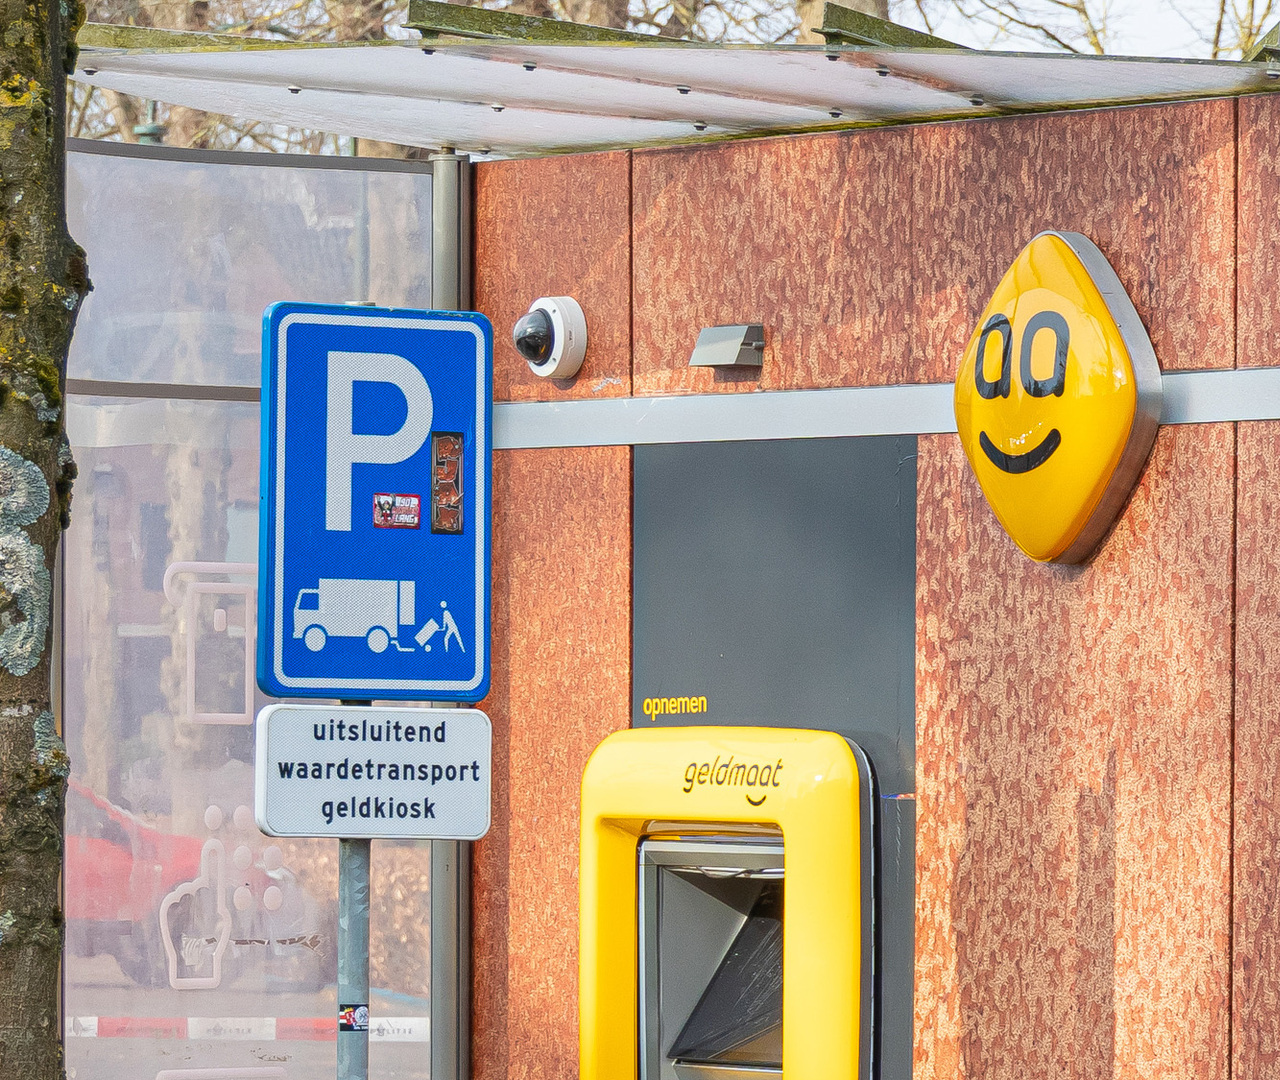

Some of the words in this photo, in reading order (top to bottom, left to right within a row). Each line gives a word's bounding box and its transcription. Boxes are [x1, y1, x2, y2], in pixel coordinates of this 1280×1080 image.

[325, 351, 434, 532] P
[643, 695, 707, 721] opnemen
[313, 719, 446, 742] uitsluitend
[278, 757, 480, 785] waardetransport
[683, 755, 784, 793] geldmaat
[322, 797, 436, 824] geldkiosk
